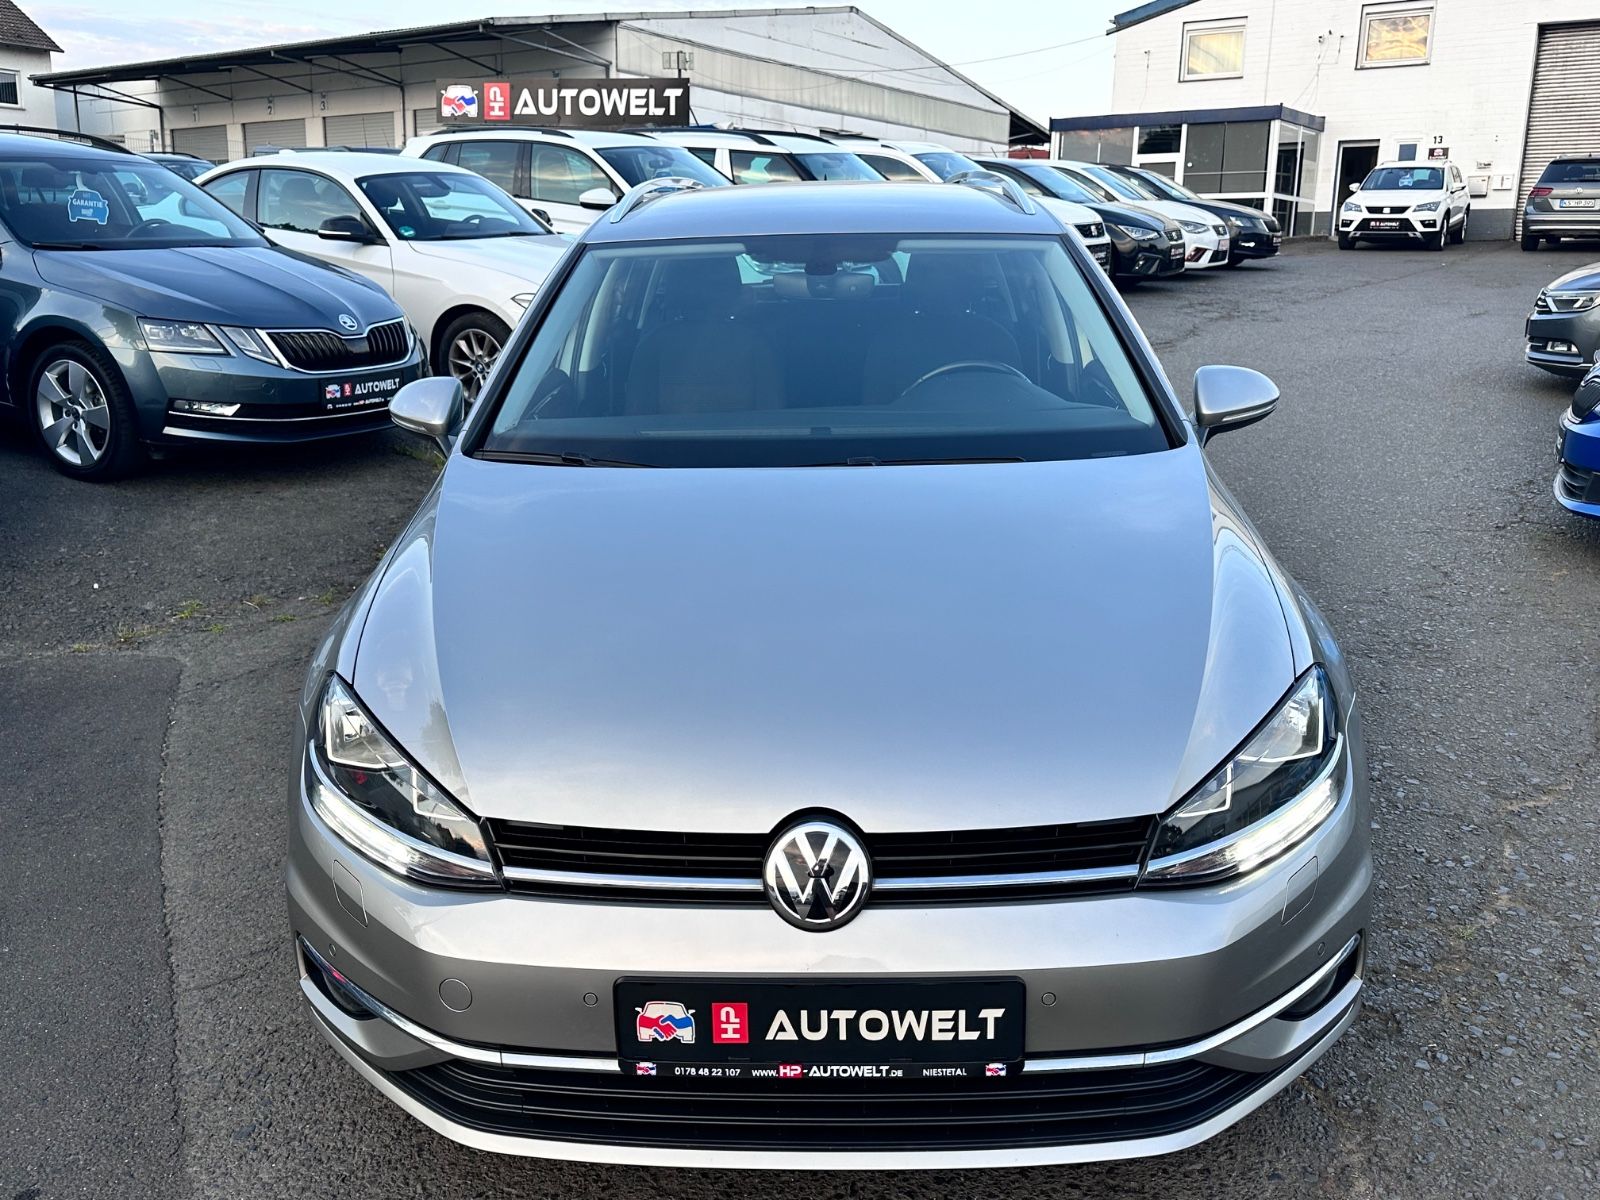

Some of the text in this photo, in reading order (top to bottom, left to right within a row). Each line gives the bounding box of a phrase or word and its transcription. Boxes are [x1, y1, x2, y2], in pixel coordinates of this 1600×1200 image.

[320, 101, 326, 111] 3
[514, 88, 683, 116] AUTOWELT
[267, 105, 273, 115] 2
[1433, 135, 1443, 144] 13
[72, 198, 103, 208] GARANTIE
[354, 377, 400, 395] AUTOWELT
[719, 1006, 1006, 1042] HP AUTOWELT
[674, 1066, 696, 1076] 0178
[698, 1067, 710, 1076] 48
[711, 1067, 723, 1077] 22
[725, 1068, 741, 1077] 107
[922, 1068, 967, 1077] NIESTETAL
